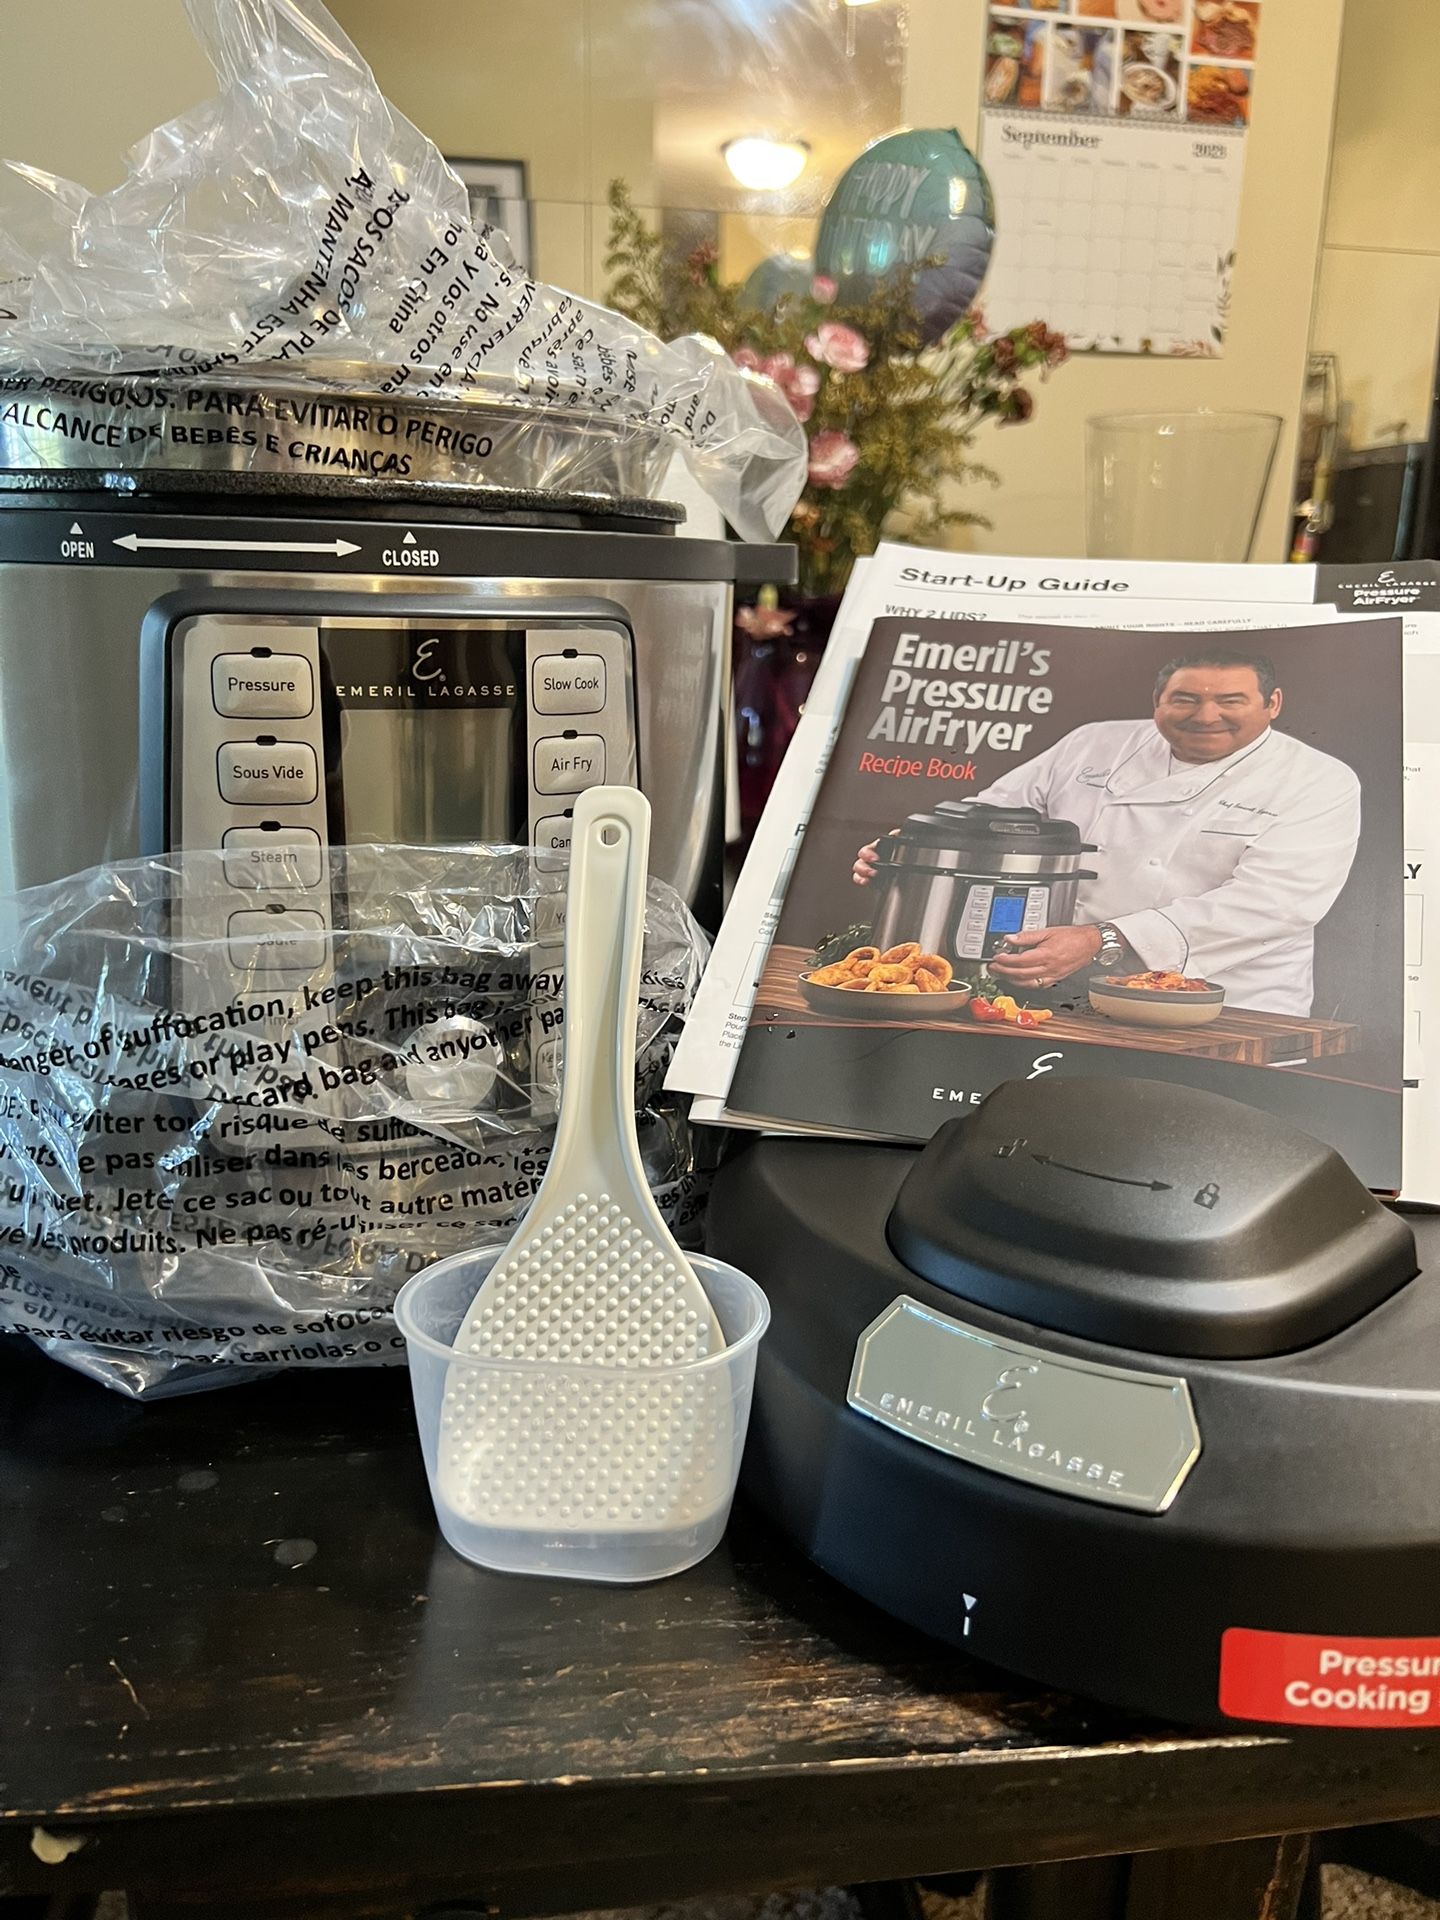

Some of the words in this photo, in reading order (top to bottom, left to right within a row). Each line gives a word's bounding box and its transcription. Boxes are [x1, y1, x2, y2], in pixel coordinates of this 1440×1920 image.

[281, 192, 354, 315] MANTENHA
[420, 247, 449, 275] En
[442, 277, 470, 310] los
[475, 292, 499, 323] No
[309, 308, 341, 337] DE
[410, 311, 447, 364] otros
[452, 323, 478, 360] use
[187, 389, 264, 418] PARA
[274, 399, 369, 431] EVITAR
[377, 414, 398, 436] O
[405, 419, 493, 458] PERIGO
[2, 403, 122, 448] ALCANCE
[171, 426, 257, 446] BEBÊS
[266, 434, 279, 454] E
[289, 441, 413, 476] CRIANÇAS
[60, 541, 95, 559] OPEN
[382, 549, 440, 568] CLOSED
[899, 566, 1027, 593] Start-Up
[1037, 577, 1131, 593] Guide
[891, 632, 1052, 677] Emeril's
[227, 677, 296, 693] Pressure
[335, 685, 416, 697] EMERIL
[428, 685, 515, 697] LAGASSE
[543, 677, 571, 692] Slow
[574, 677, 600, 691] Cook
[880, 668, 1053, 715] Pressure
[866, 706, 1033, 755] AirFryer
[232, 765, 269, 781] Sous
[272, 765, 304, 781] Vide
[551, 757, 570, 772] Air
[573, 756, 593, 775] Fry
[858, 752, 923, 778] Recipe
[926, 758, 978, 781] Book
[250, 850, 298, 863] Steam
[120, 998, 294, 1051] suffocation,
[303, 976, 373, 1013] keep
[382, 966, 433, 992] this
[441, 966, 492, 992] bag
[498, 973, 565, 996] away
[190, 1055, 220, 1078] or
[230, 1038, 292, 1077] play
[303, 1020, 375, 1056] pens.
[385, 1000, 439, 1031] This
[320, 1059, 376, 1091] bag
[381, 1044, 424, 1071] and
[932, 1087, 982, 1105] EME
[221, 1111, 308, 1138] risque
[106, 1151, 155, 1175] pas
[265, 1144, 330, 1168] dans
[379, 1149, 505, 1181] berceaux,
[183, 1196, 216, 1213] ce
[226, 1187, 272, 1208] sac
[279, 1187, 312, 1207] ou
[380, 1194, 454, 1216] autre
[462, 1176, 545, 1208] matér
[70, 1226, 186, 1256] produits.
[196, 1227, 236, 1247] Ne
[248, 1223, 292, 1244] pas
[80, 1327, 153, 1344] evitar
[162, 1325, 245, 1342] riesgo
[252, 1323, 287, 1335] de
[240, 1342, 357, 1363] carriolas
[364, 1340, 381, 1352] o
[879, 1392, 977, 1437] EMERIL
[991, 1429, 1126, 1488] LAGASSE
[1319, 1648, 1440, 1677] Pressur
[1284, 1680, 1431, 1715] Cooking
